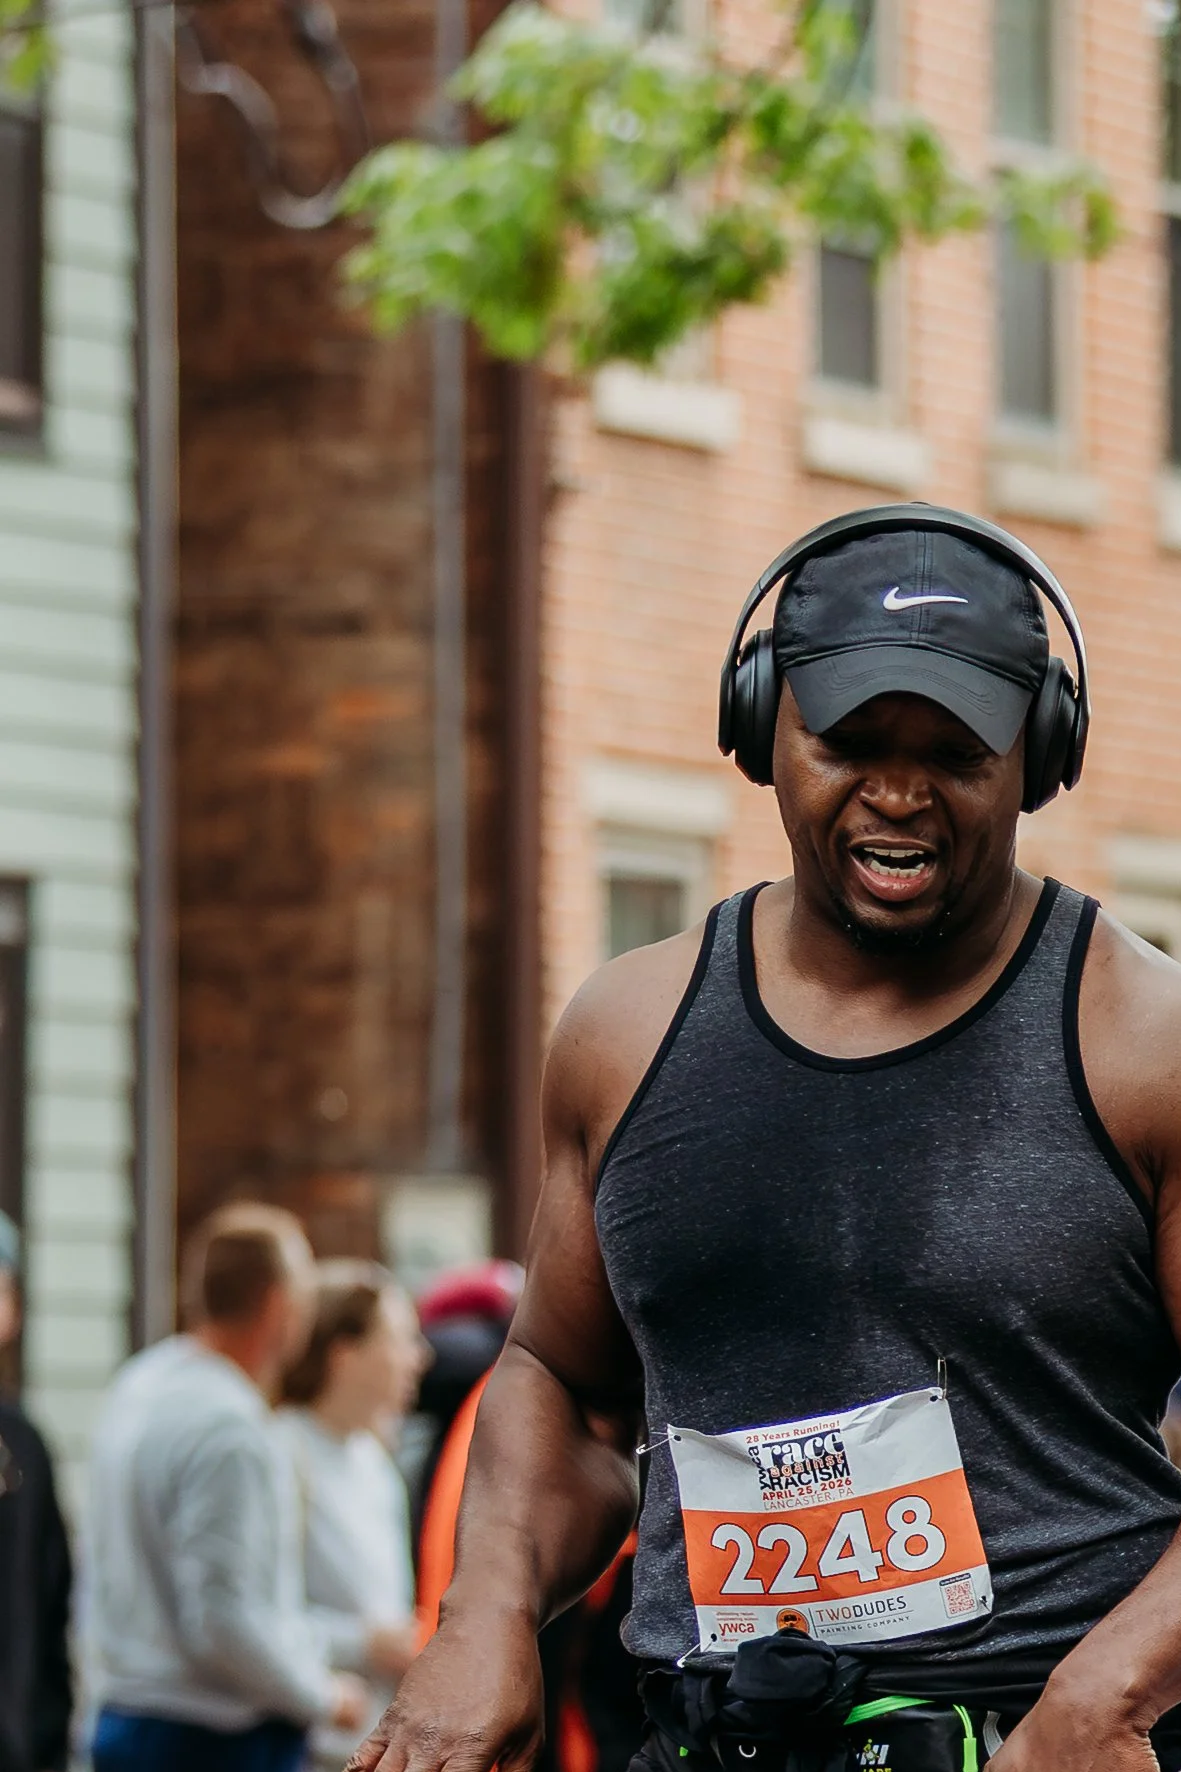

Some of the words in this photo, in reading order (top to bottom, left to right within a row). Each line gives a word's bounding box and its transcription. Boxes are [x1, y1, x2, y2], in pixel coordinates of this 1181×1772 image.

[746, 1435, 760, 1444] 28
[762, 1432, 791, 1441] Years
[793, 1420, 840, 1436] Running!
[760, 1432, 845, 1470] race
[767, 1454, 851, 1491] RACISM
[762, 1490, 795, 1501] APRIL
[797, 1485, 818, 1496] 25,
[820, 1478, 852, 1492] 2026
[763, 1491, 836, 1511] LANCASTER,
[838, 1487, 855, 1498] PA
[710, 1495, 947, 1595] 2248
[719, 1622, 755, 1637] ywca
[820, 1624, 863, 1635] PAINTING
[866, 1615, 911, 1629] COMPANY
